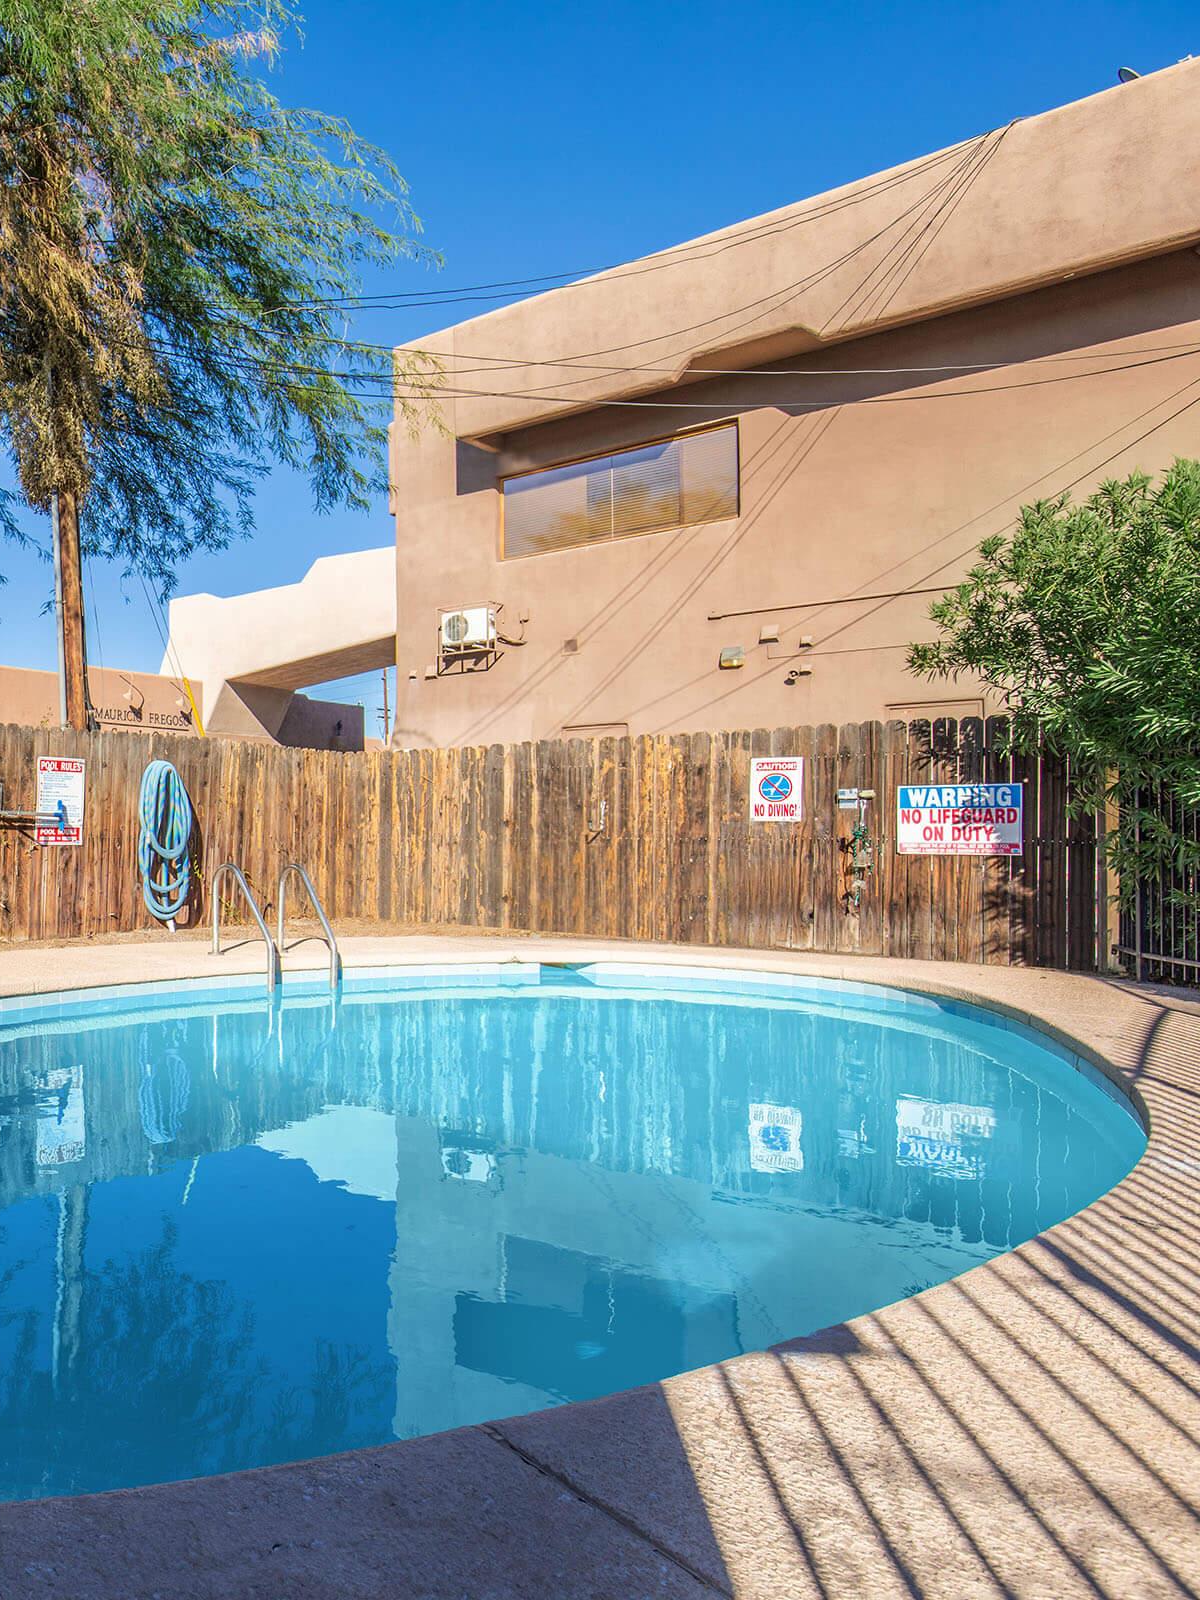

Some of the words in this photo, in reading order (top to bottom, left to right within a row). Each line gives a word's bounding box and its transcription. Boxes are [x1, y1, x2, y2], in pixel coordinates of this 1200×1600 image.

[40, 761, 59, 771] POOL
[757, 762, 797, 770] CAUTION!
[908, 787, 1012, 807] WARNING
[754, 804, 765, 817] NO
[768, 804, 797, 817] DIVING!
[901, 809, 921, 824] NO
[930, 808, 1017, 824] LIFEGUARD
[922, 826, 943, 841] ON
[952, 826, 994, 841] DUTY
